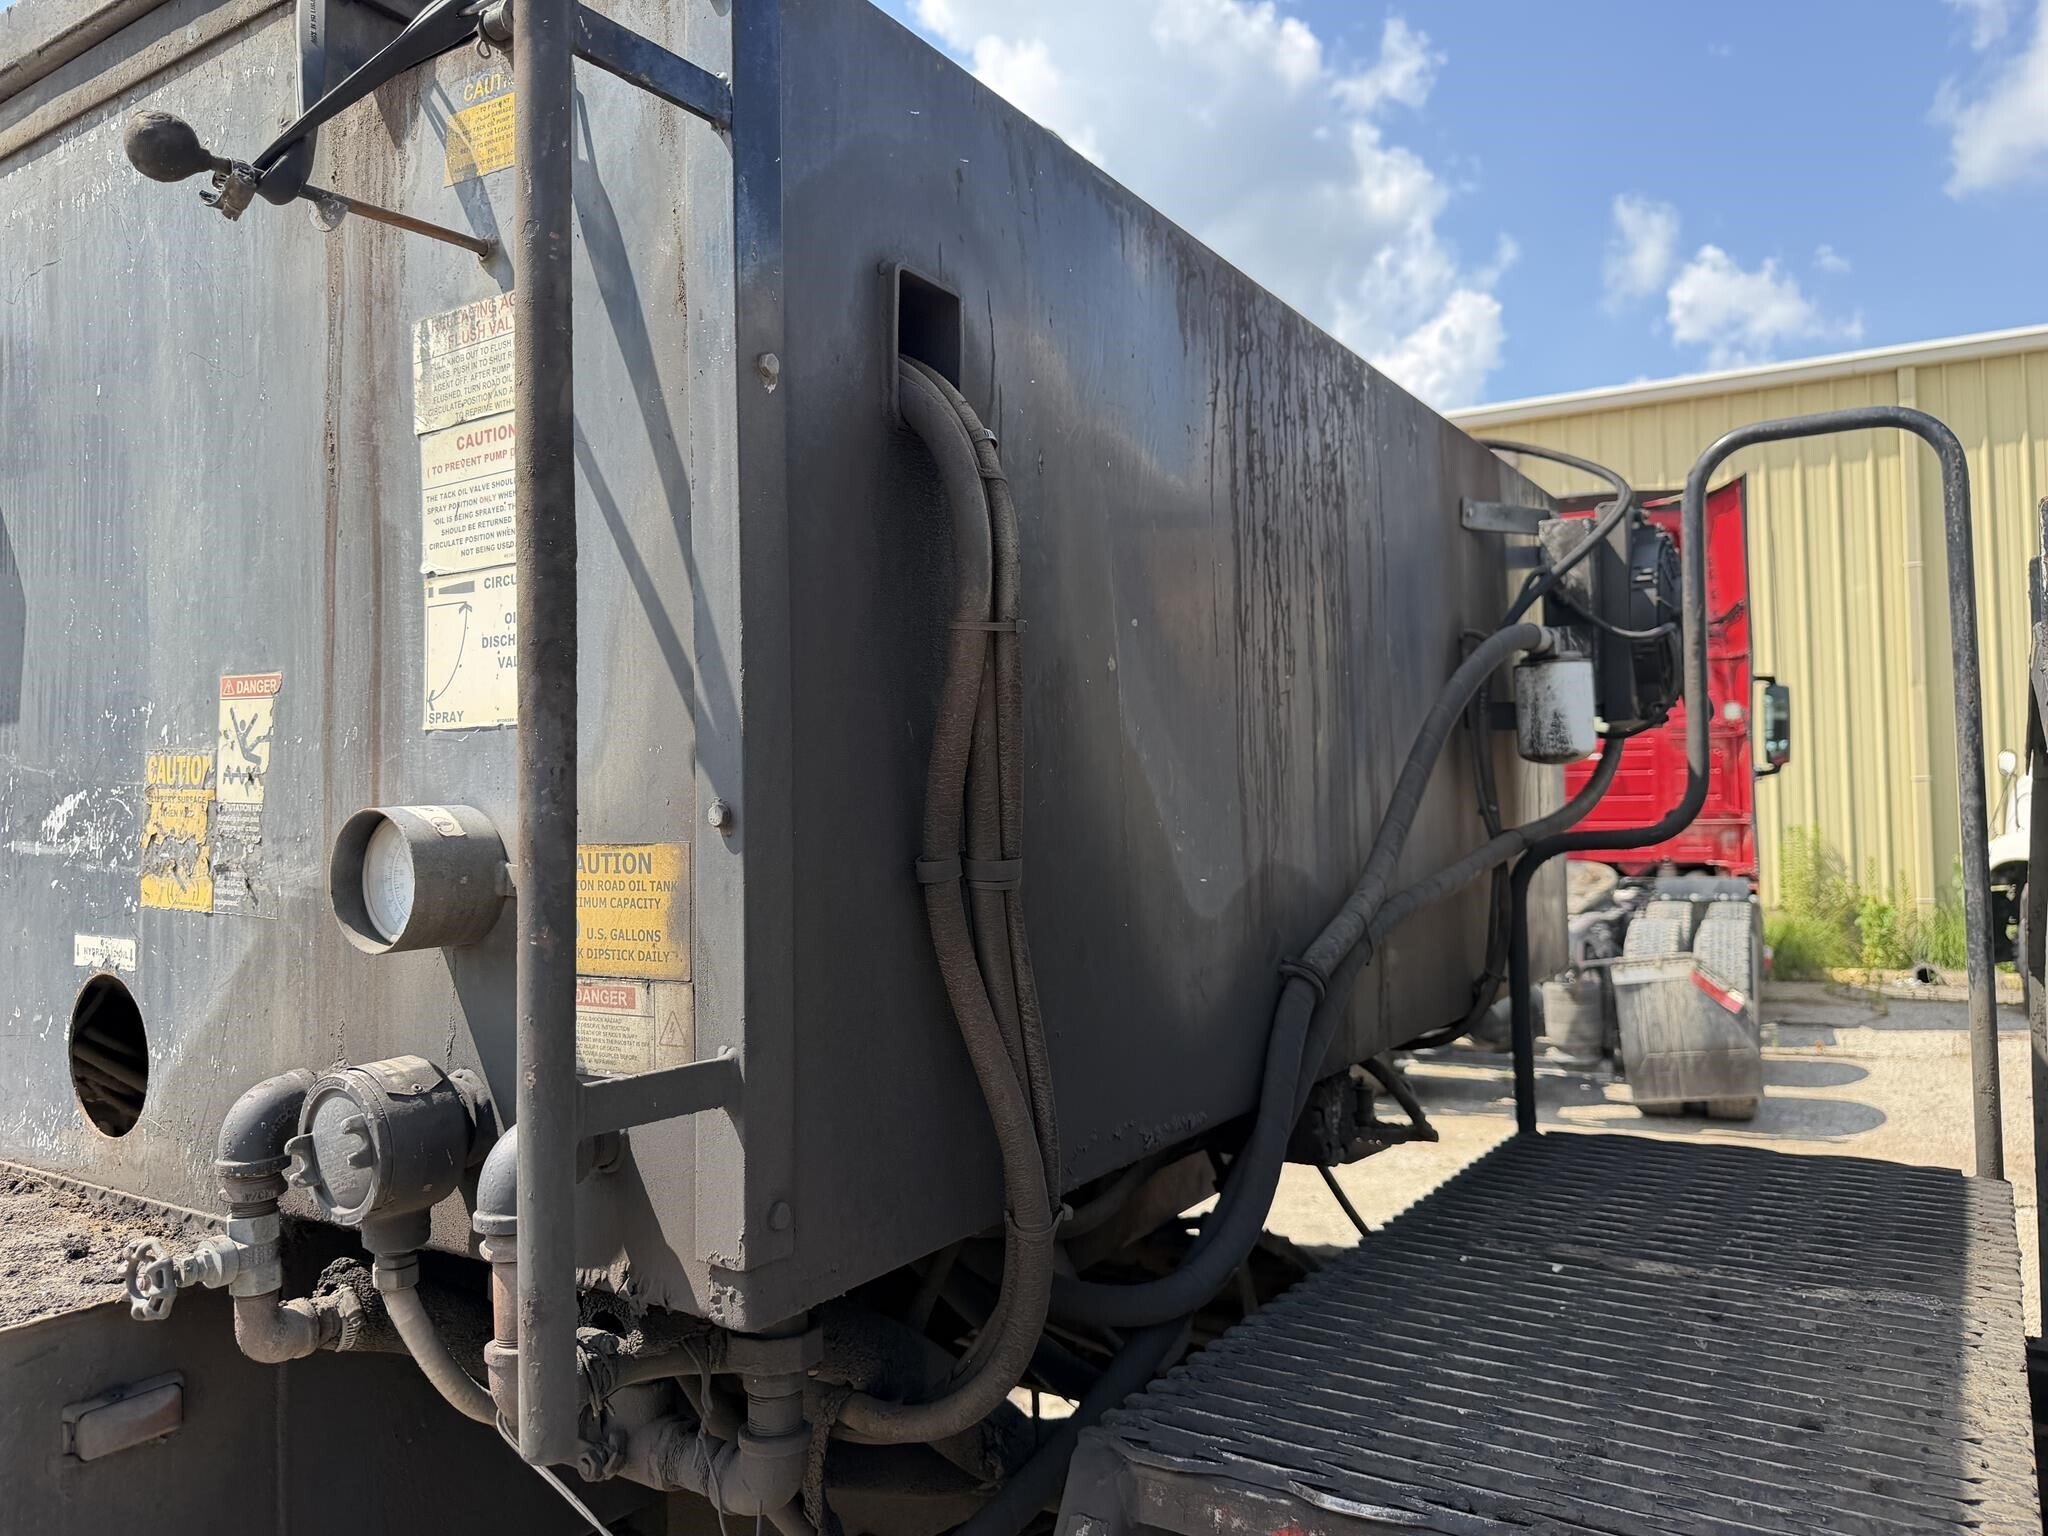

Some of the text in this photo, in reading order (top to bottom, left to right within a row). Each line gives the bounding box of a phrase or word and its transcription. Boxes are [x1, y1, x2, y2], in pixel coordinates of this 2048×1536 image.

[464, 73, 514, 102] CAUT
[431, 301, 497, 332] RELEASING
[448, 314, 515, 349] FLUSH VAL
[432, 340, 512, 370] ULL KNOB OUT TO FLUSH
[453, 363, 470, 375] PUSH
[471, 361, 478, 370] IN
[479, 358, 488, 367] TO
[489, 353, 506, 365] SHUT
[434, 380, 453, 392] AGENT
[471, 369, 491, 381] AFTER
[492, 363, 511, 375] PUMP
[464, 383, 481, 395] TURN
[483, 378, 500, 389] ROAD
[502, 374, 513, 384] OIL
[427, 400, 463, 417] CIRCULATE
[463, 391, 492, 405] POSITION
[494, 387, 508, 398] AND
[455, 398, 511, 420] TO REPRIME WITH
[456, 423, 516, 451] CAUTION
[445, 455, 481, 472] PREVENT
[484, 450, 508, 463] PUMP
[426, 478, 515, 503] THE TACK OIL VALVE SHOUL
[427, 504, 447, 515] SPRAY
[448, 499, 478, 510] POSITION
[480, 494, 496, 503] ONLY
[434, 517, 445, 525] OIL
[447, 515, 453, 523] IS
[454, 511, 473, 522] BEING
[441, 516, 512, 536] SHOULD BE RETURNED
[429, 528, 516, 550] CIRCULATE POSITION WHEN
[461, 548, 474, 557] NOT
[475, 544, 495, 554] BEING
[484, 574, 517, 589] CIRCU
[504, 611, 516, 624] OI
[482, 633, 516, 648] DISCH
[497, 655, 517, 668] VAL
[236, 679, 277, 694] DANGER
[428, 711, 464, 724] SPRAY
[177, 795, 206, 803] SURFACE
[577, 852, 652, 874] AUTION
[597, 880, 625, 891] ROAD
[628, 880, 647, 892] OIL
[649, 880, 678, 892] TANK
[577, 897, 661, 909] IMUM CAPACITY
[587, 927, 661, 942] U.S. GALLONS
[586, 948, 635, 961] DIPSTICK
[638, 950, 670, 963] DAILY
[576, 988, 627, 1006] DANGER
